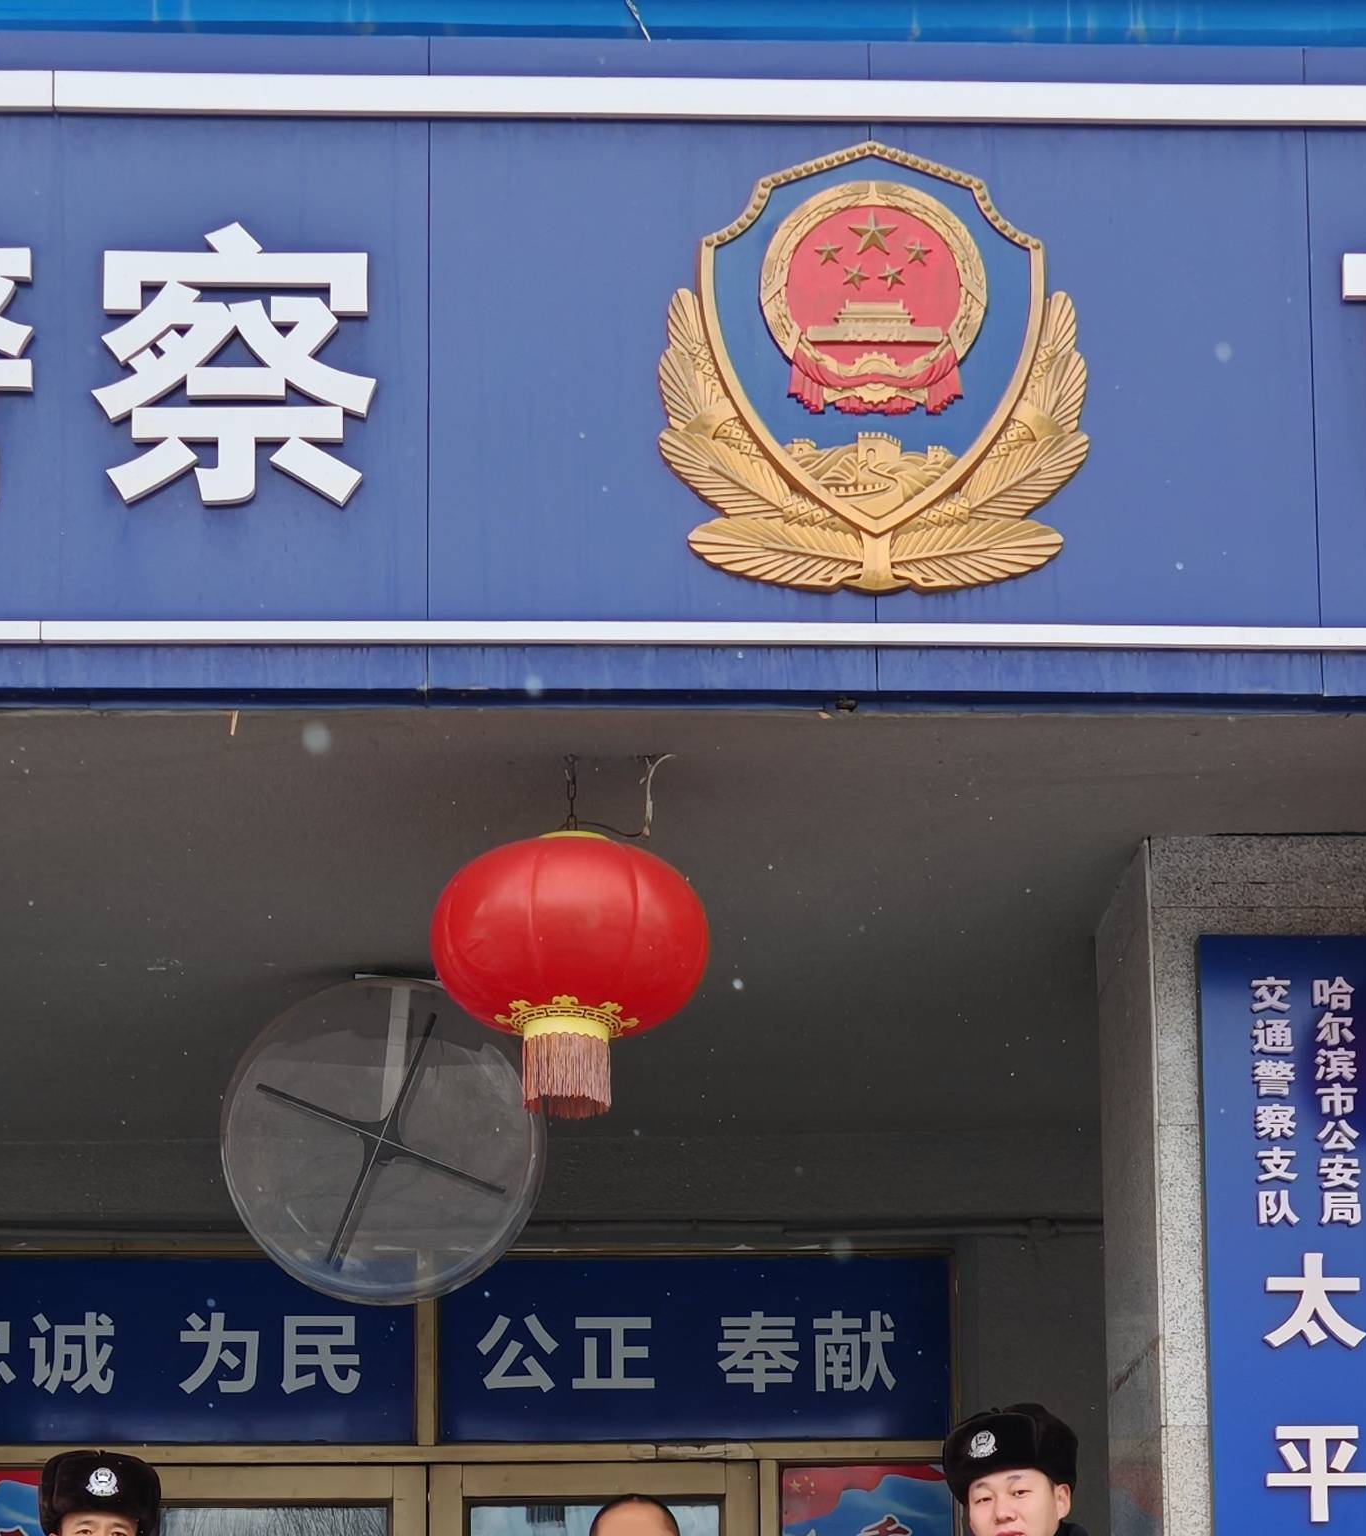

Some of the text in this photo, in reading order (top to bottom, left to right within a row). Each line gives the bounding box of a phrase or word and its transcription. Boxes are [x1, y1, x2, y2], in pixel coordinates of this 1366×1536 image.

[1249, 974, 1301, 1227] 交通警察支队
[1311, 974, 1363, 1227] 哈尔滨市公安局
[179, 1312, 362, 1395] 为民
[476, 1313, 656, 1393] 公正
[716, 1310, 897, 1394] 奉献
